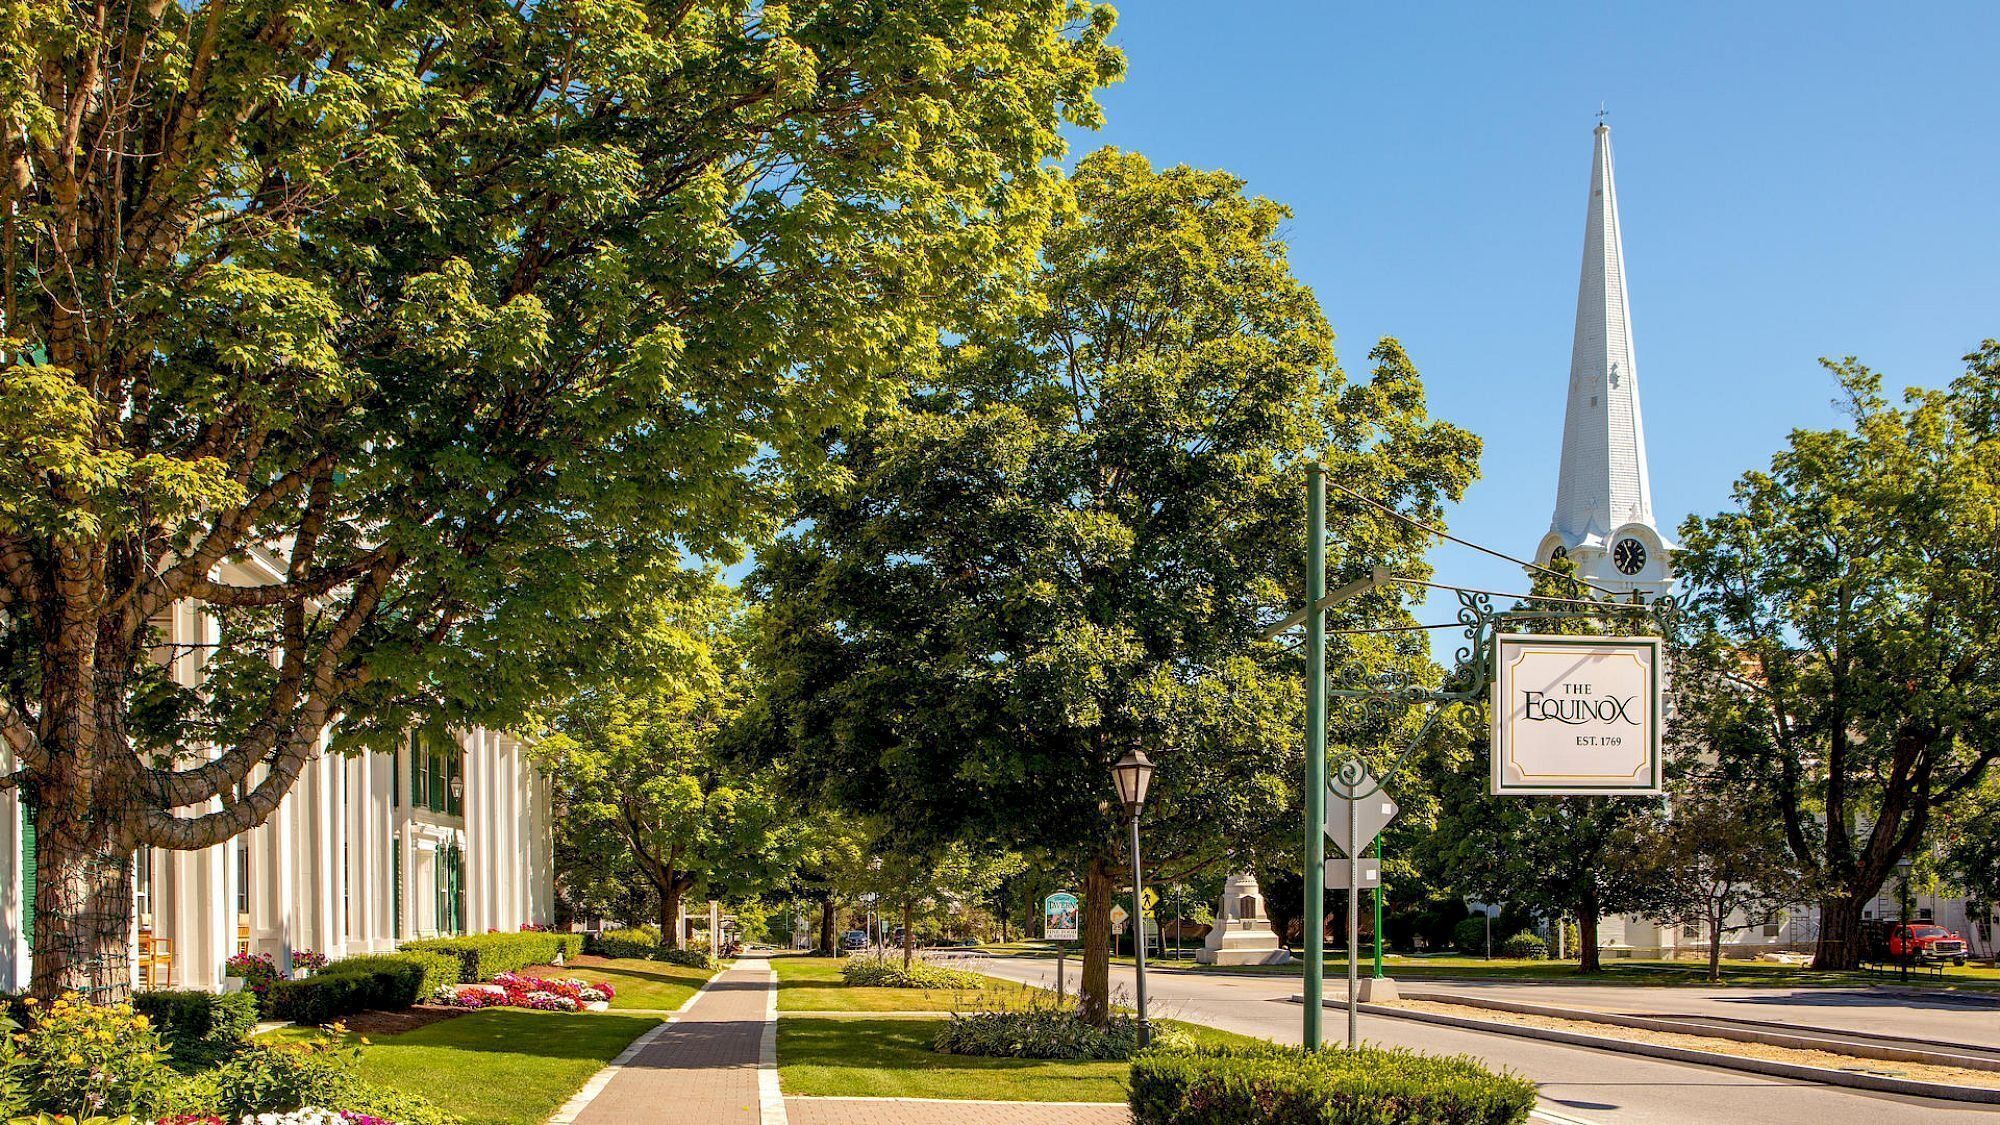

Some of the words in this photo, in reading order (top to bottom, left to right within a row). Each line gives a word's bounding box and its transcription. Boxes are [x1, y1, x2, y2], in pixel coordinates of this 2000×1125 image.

[1563, 684, 1592, 695] THE
[1520, 689, 1642, 725] EQUINOX
[1576, 736, 1598, 746] EST.
[1601, 736, 1622, 746] 1769
[1049, 901, 1076, 909] TAVERN
